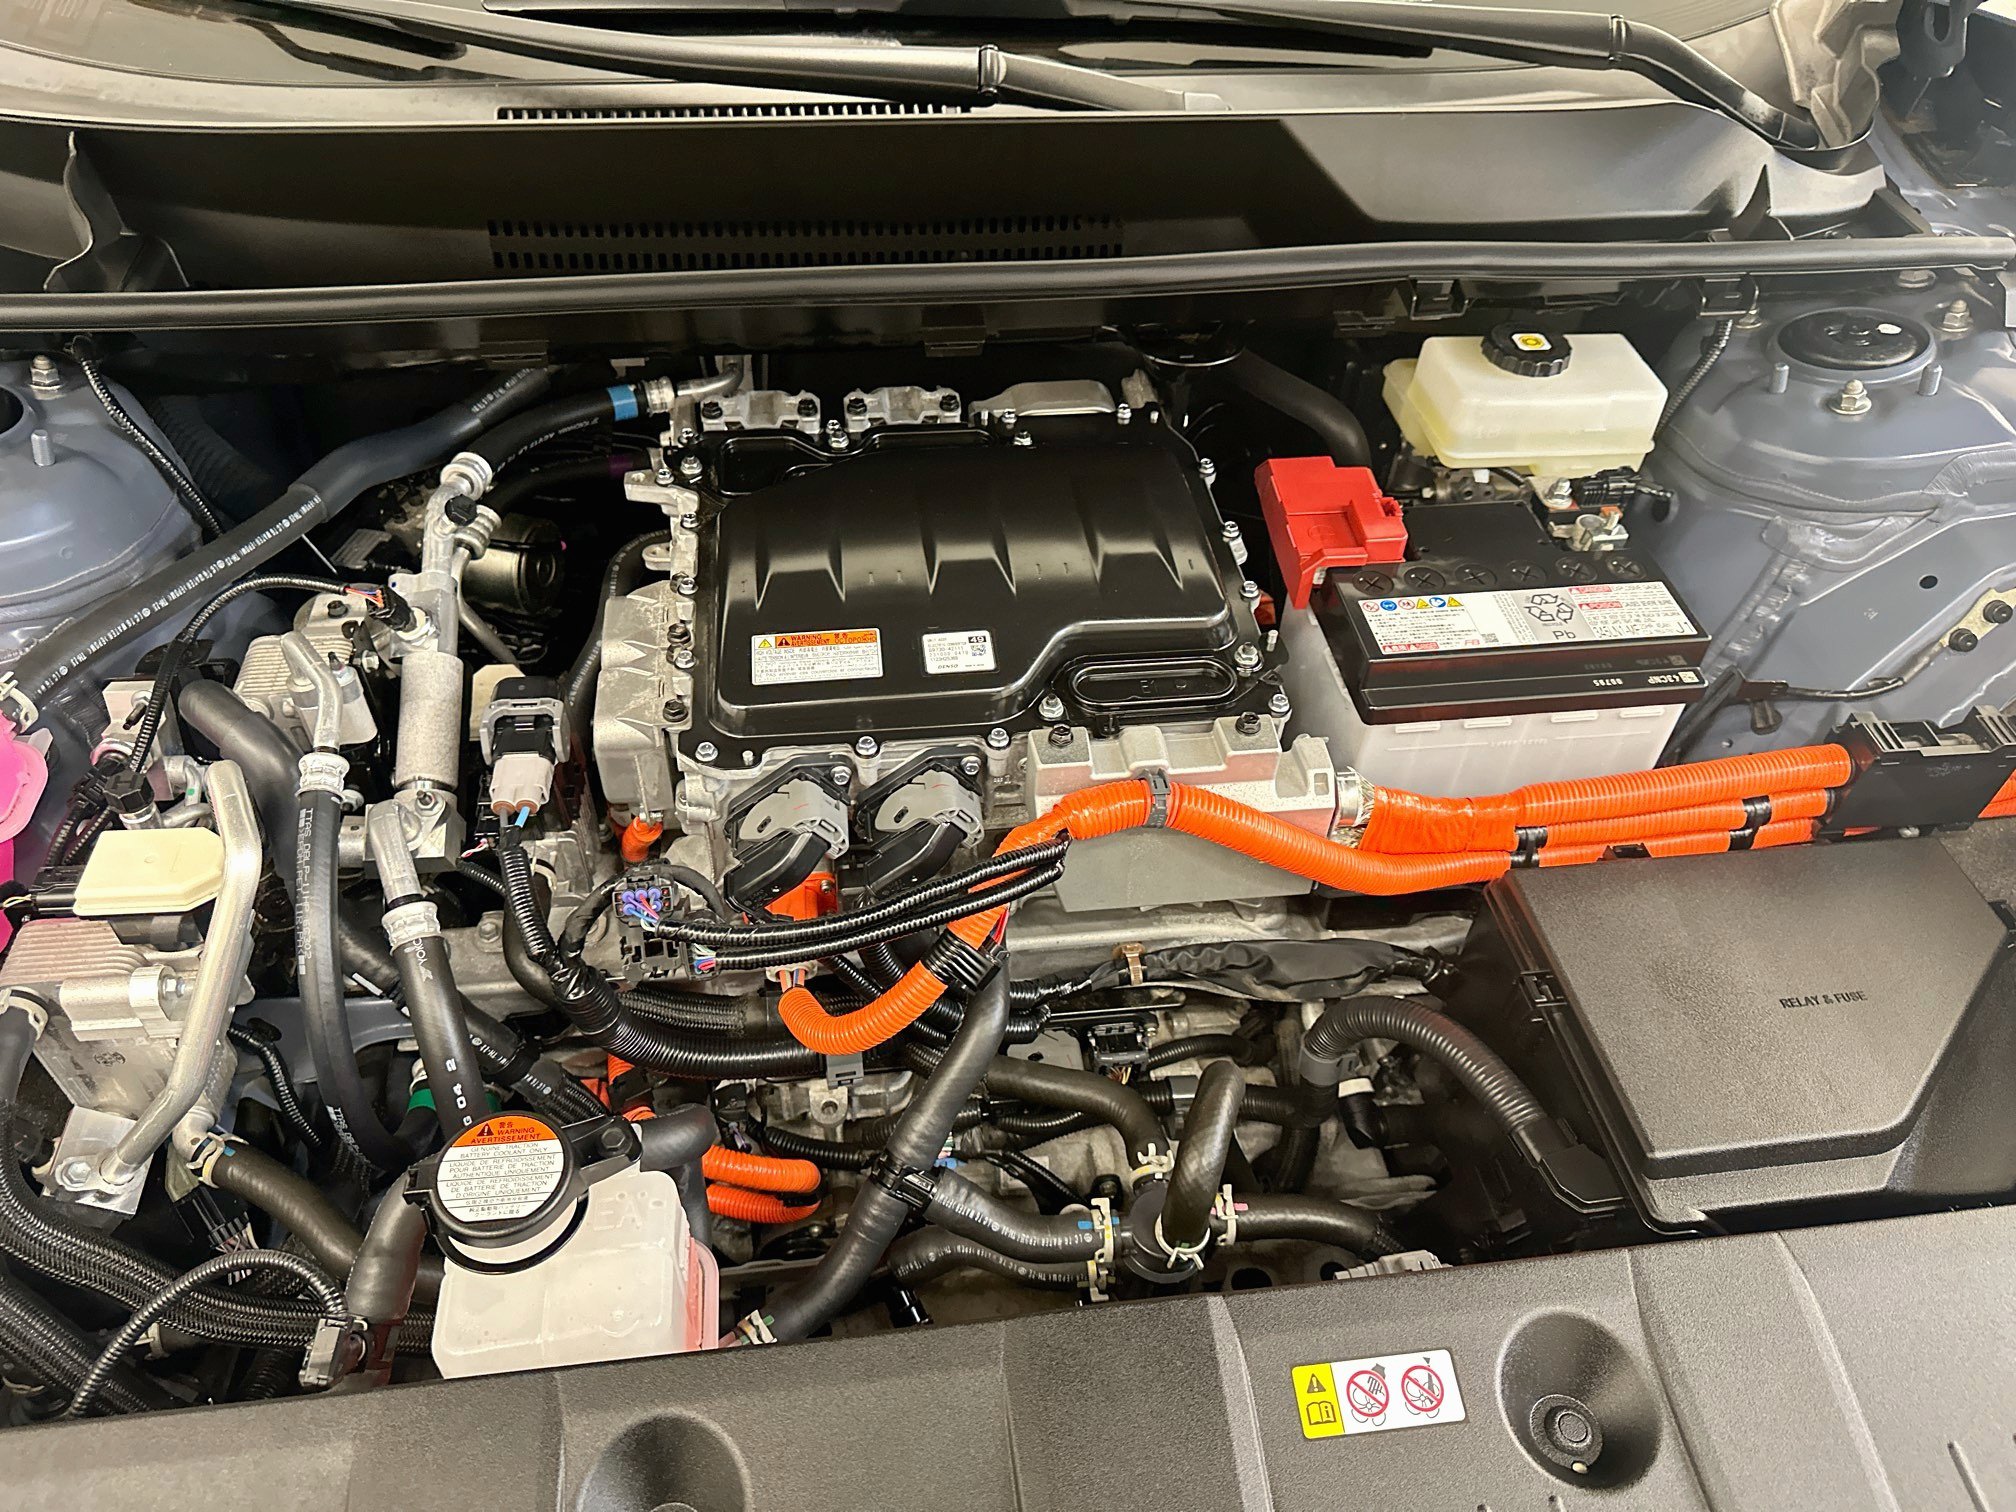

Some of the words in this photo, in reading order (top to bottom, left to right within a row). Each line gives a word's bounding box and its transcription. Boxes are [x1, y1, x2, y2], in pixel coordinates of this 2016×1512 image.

[1553, 630, 1576, 640] Pb
[1779, 995, 1820, 1008] RELAY
[1822, 994, 1834, 1004] &
[1833, 991, 1868, 1003] FUSE
[497, 1127, 535, 1135] WARNING
[471, 1133, 541, 1144] AVERTISSEMENT
[505, 1142, 539, 1150] TRACTION
